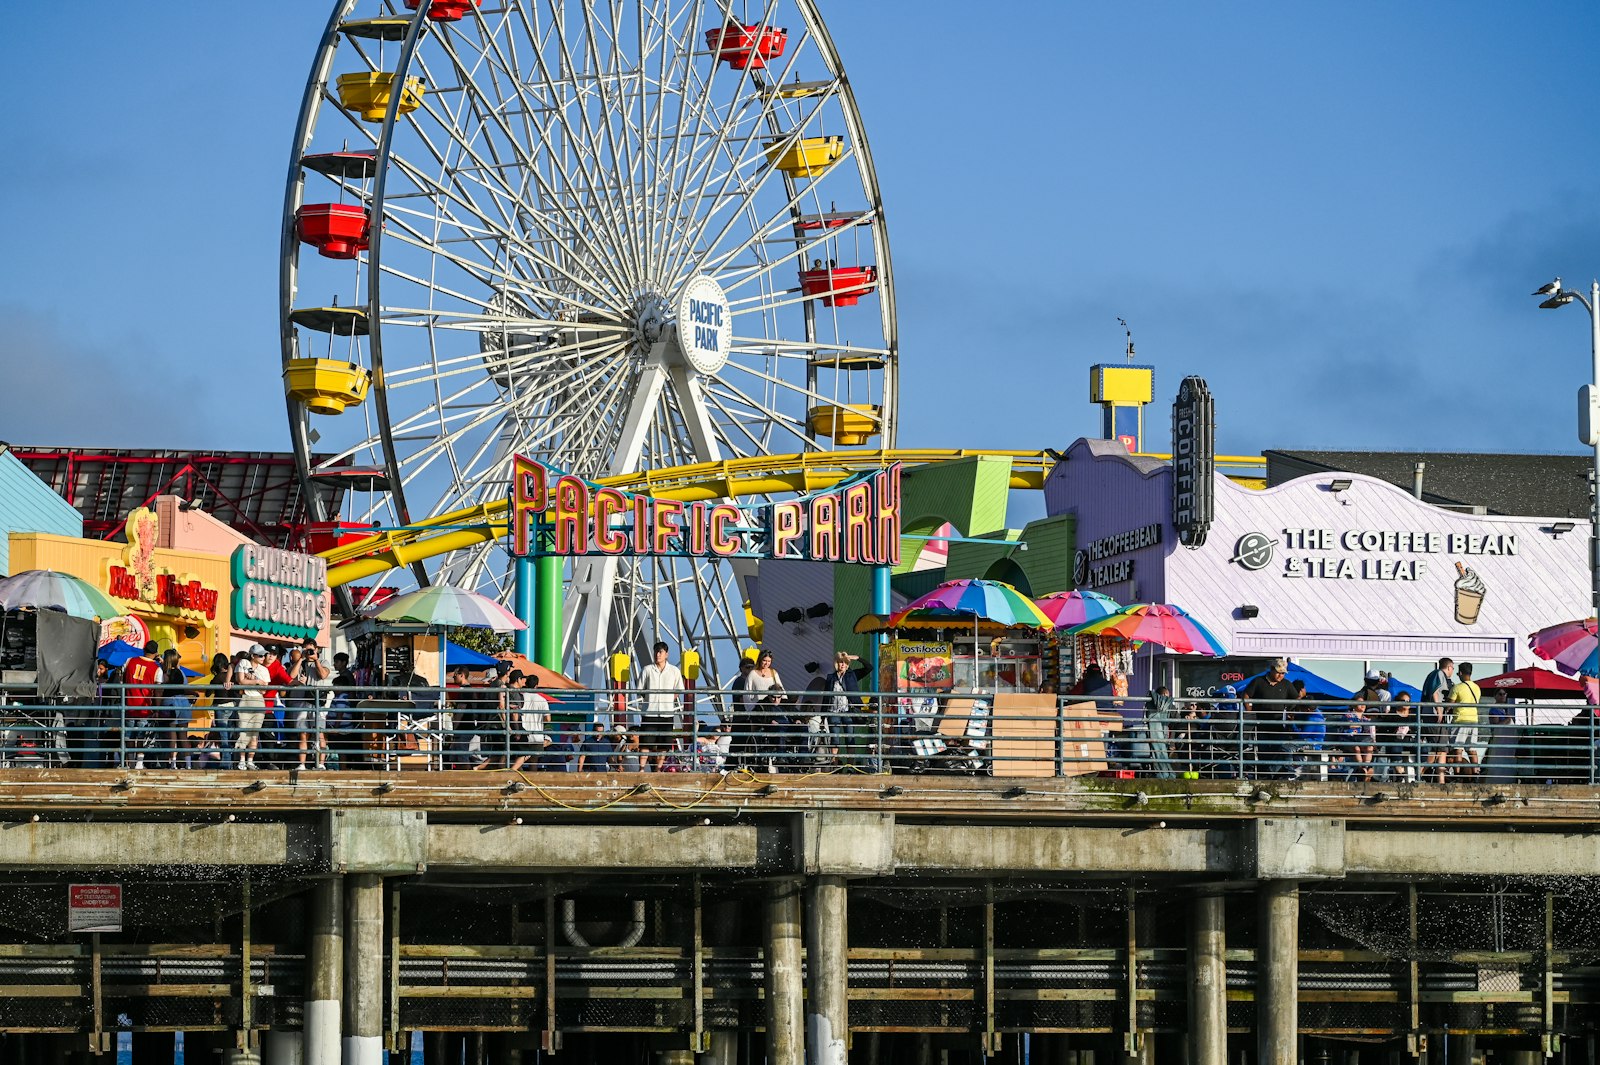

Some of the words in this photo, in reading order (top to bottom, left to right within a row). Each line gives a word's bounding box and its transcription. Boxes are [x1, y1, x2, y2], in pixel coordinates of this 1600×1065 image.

[689, 298, 723, 328] PACIFIC
[694, 325, 719, 352] PARK
[1177, 419, 1192, 525] COFFEE
[513, 452, 742, 556] PACIFIC
[771, 460, 902, 566] PARK
[1283, 527, 1336, 550] THE
[1341, 529, 1442, 553] COFFEE
[1448, 532, 1520, 556] BEAN
[243, 543, 328, 592] CHURRITA
[1304, 557, 1358, 579] TEA
[1362, 558, 1428, 581] LEAF
[243, 581, 327, 631] CHURROS
[132, 663, 147, 681] 11
[1221, 672, 1244, 681] OPEN
